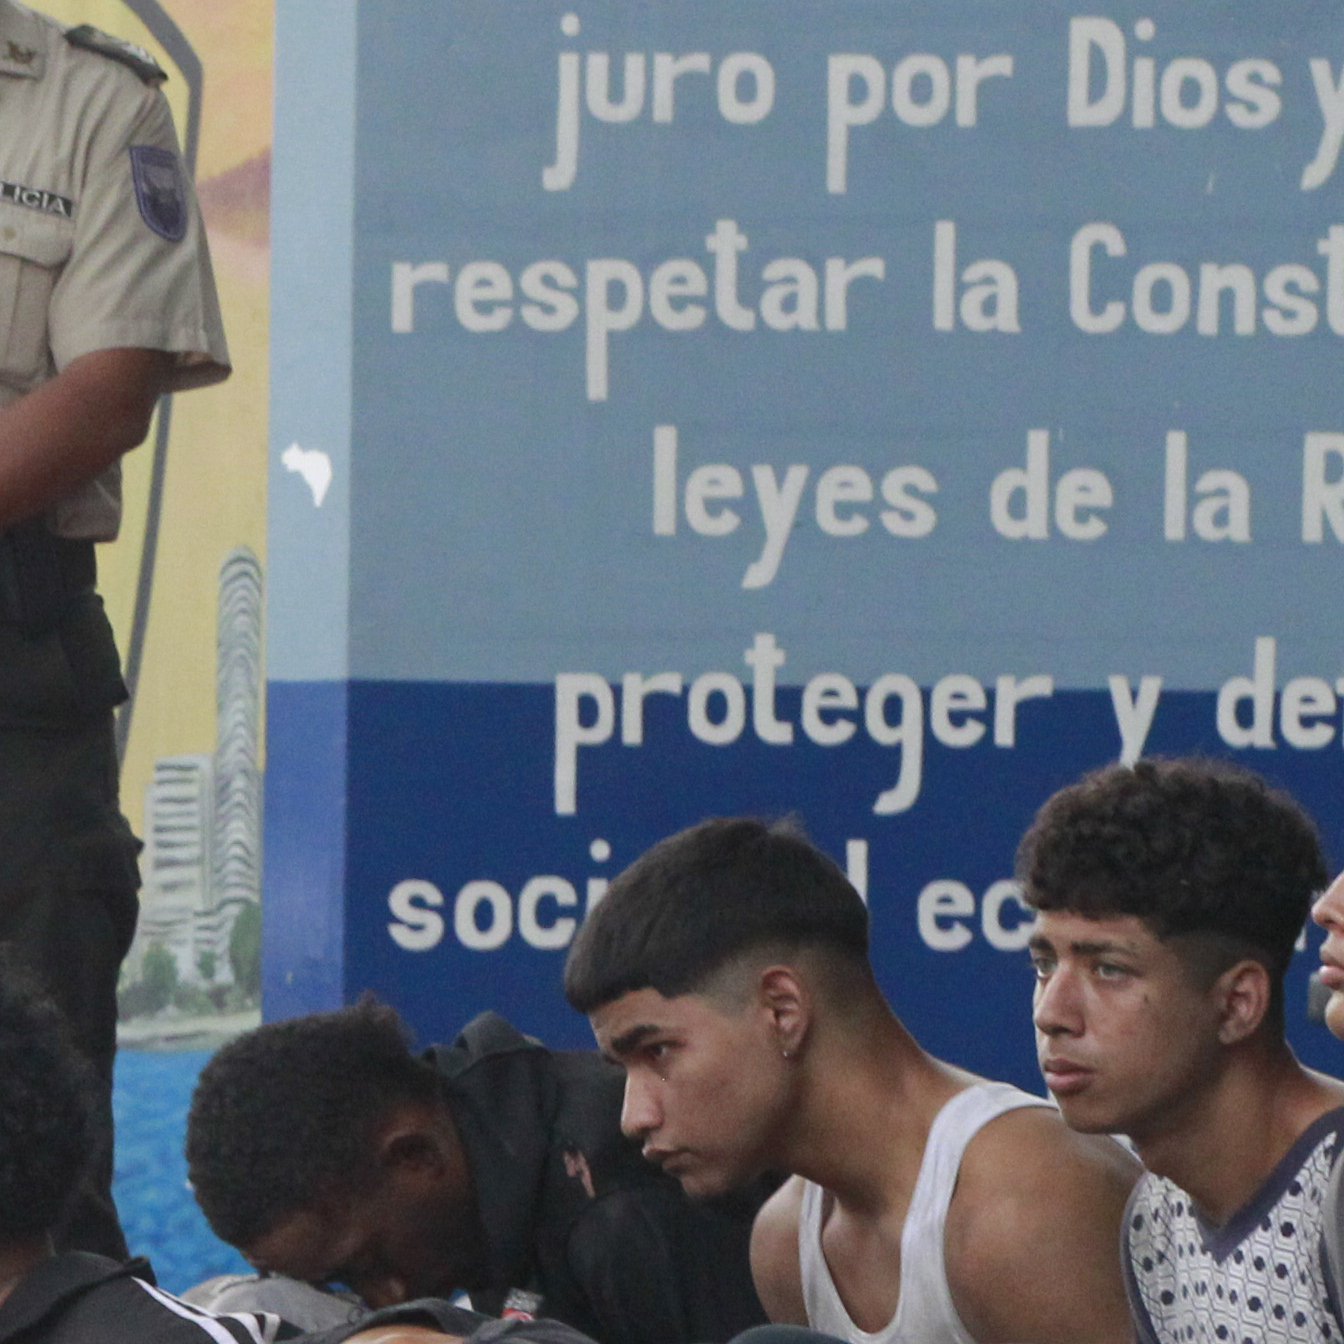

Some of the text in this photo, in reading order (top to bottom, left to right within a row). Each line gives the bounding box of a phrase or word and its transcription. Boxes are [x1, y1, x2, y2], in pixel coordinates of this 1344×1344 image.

[541, 10, 1344, 195] juro por Dios y
[388, 218, 888, 404] respetar
[931, 218, 1024, 335] la
[651, 423, 939, 590] leyes
[988, 427, 1114, 543] de
[1163, 429, 1254, 544] la
[554, 631, 1344, 814] proteger y de
